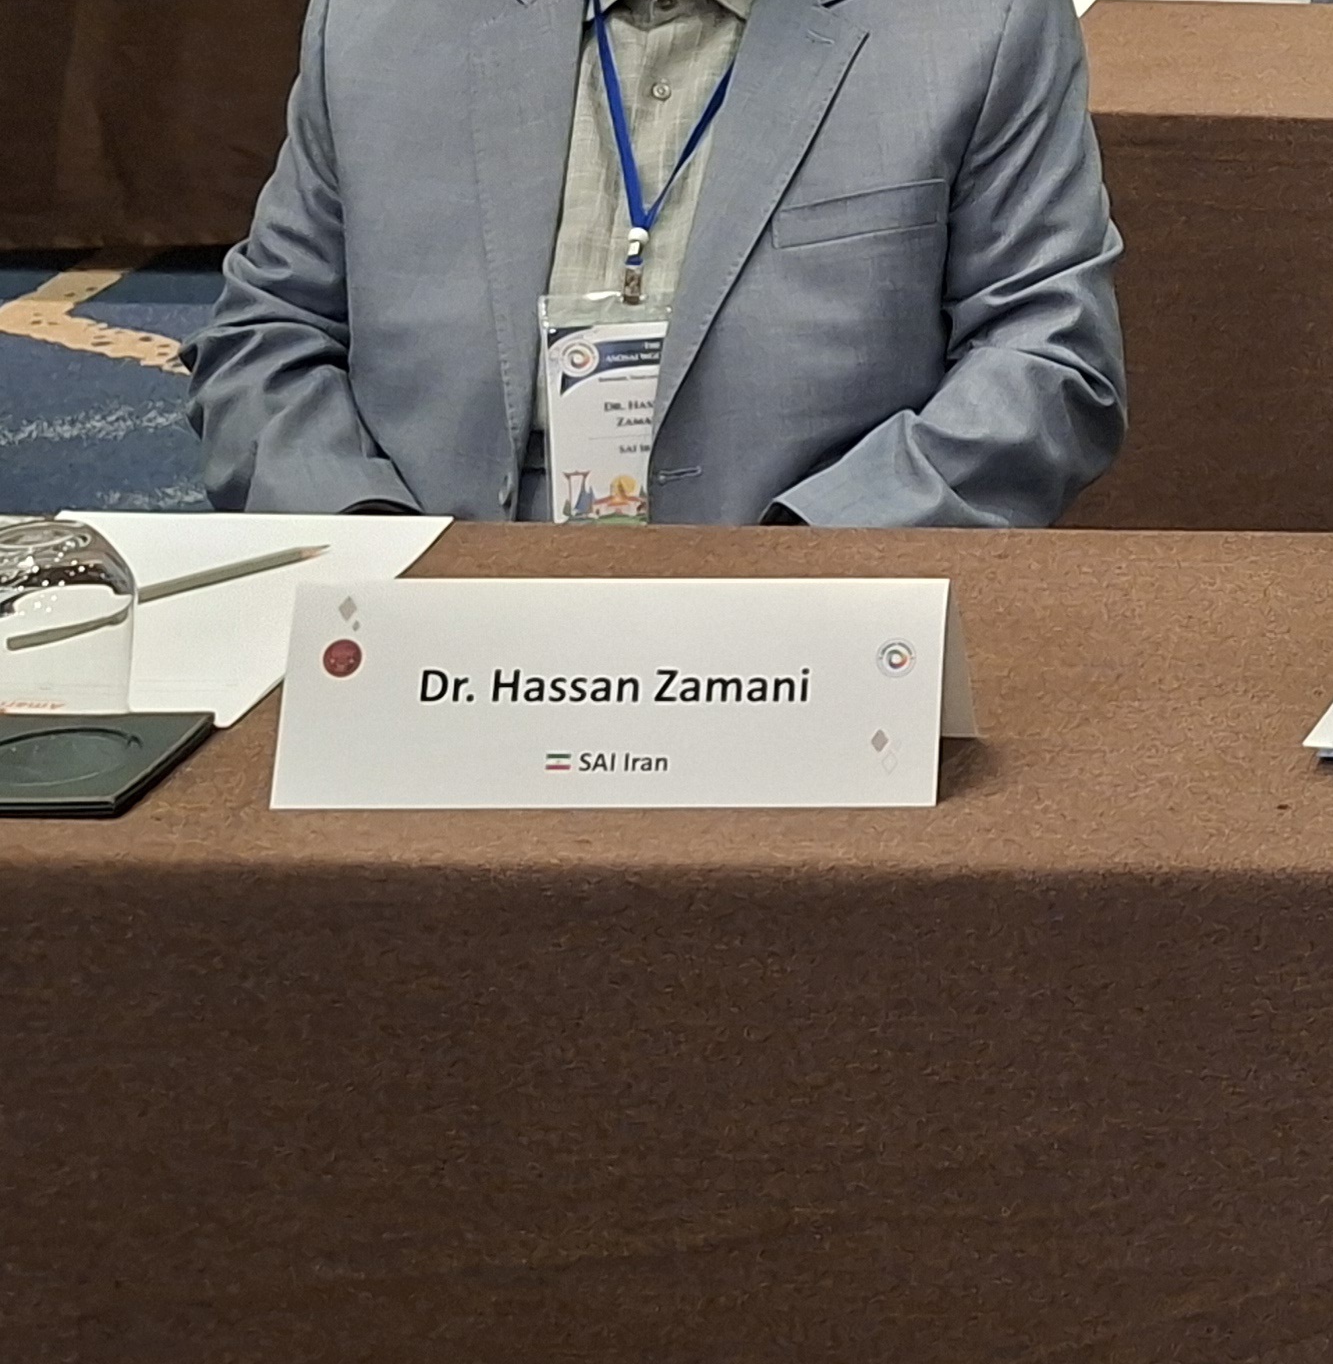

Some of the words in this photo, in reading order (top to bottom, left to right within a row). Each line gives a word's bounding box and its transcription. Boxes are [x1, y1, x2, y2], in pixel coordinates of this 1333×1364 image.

[419, 669, 475, 703] Dr.
[491, 668, 640, 703] Hassan
[653, 667, 811, 703] Zamani
[578, 752, 616, 772] SAI
[623, 752, 668, 772] Iran
